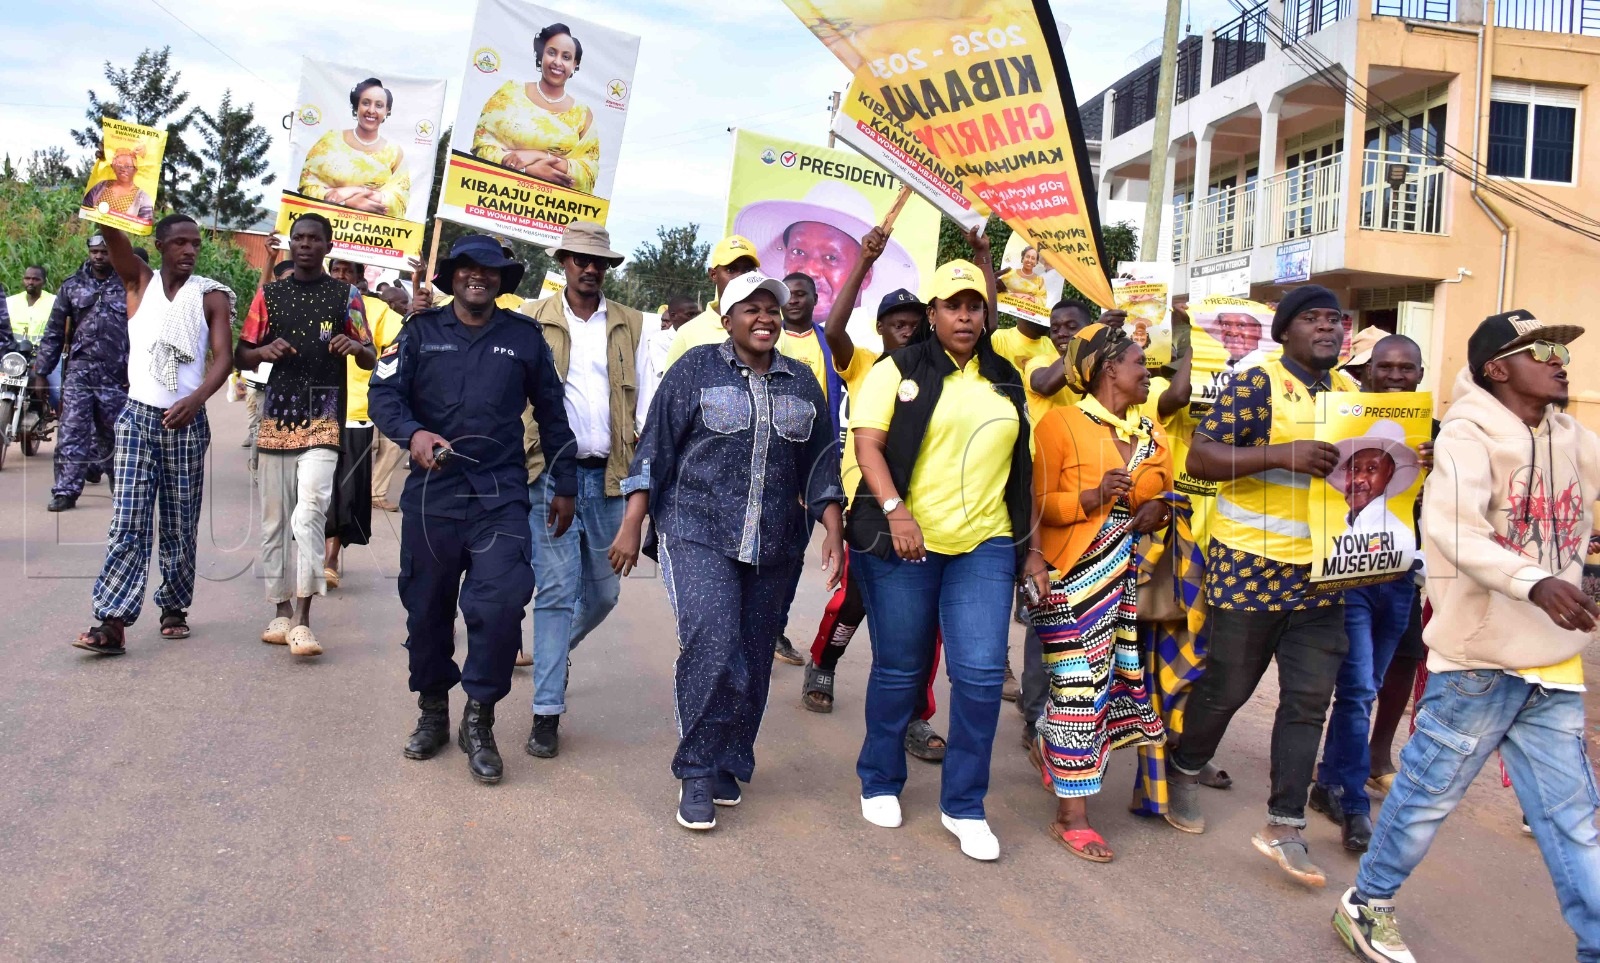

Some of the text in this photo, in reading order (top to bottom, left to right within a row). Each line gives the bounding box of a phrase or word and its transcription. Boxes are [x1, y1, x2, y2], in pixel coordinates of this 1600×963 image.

[113, 124, 145, 136] ATUKWASA
[146, 131, 159, 140] RITA
[870, 116, 964, 194] KAMUHANDA
[799, 155, 896, 190] PRESIDENT
[860, 124, 876, 139] FOR
[876, 135, 906, 160] WOMAN
[905, 156, 918, 168] MP
[917, 165, 951, 195] MBARARA
[951, 192, 968, 206] CITY
[461, 177, 602, 218] KIBAAJU CHARITY
[469, 207, 485, 216] FOR
[486, 210, 518, 224] WOMAN
[518, 217, 531, 226] MP
[333, 229, 393, 248] UHANDA
[353, 222, 413, 239] CHARITY
[340, 242, 350, 250] MP
[351, 244, 384, 254] MBARARA
[384, 249, 400, 257] CITY
[493, 346, 514, 356] PPG
[1364, 406, 1420, 418] PRESIDENT
[1332, 531, 1394, 555] YOWERI
[1322, 551, 1402, 576] MUSEVENI
[1316, 578, 1359, 590] PROTECTING
